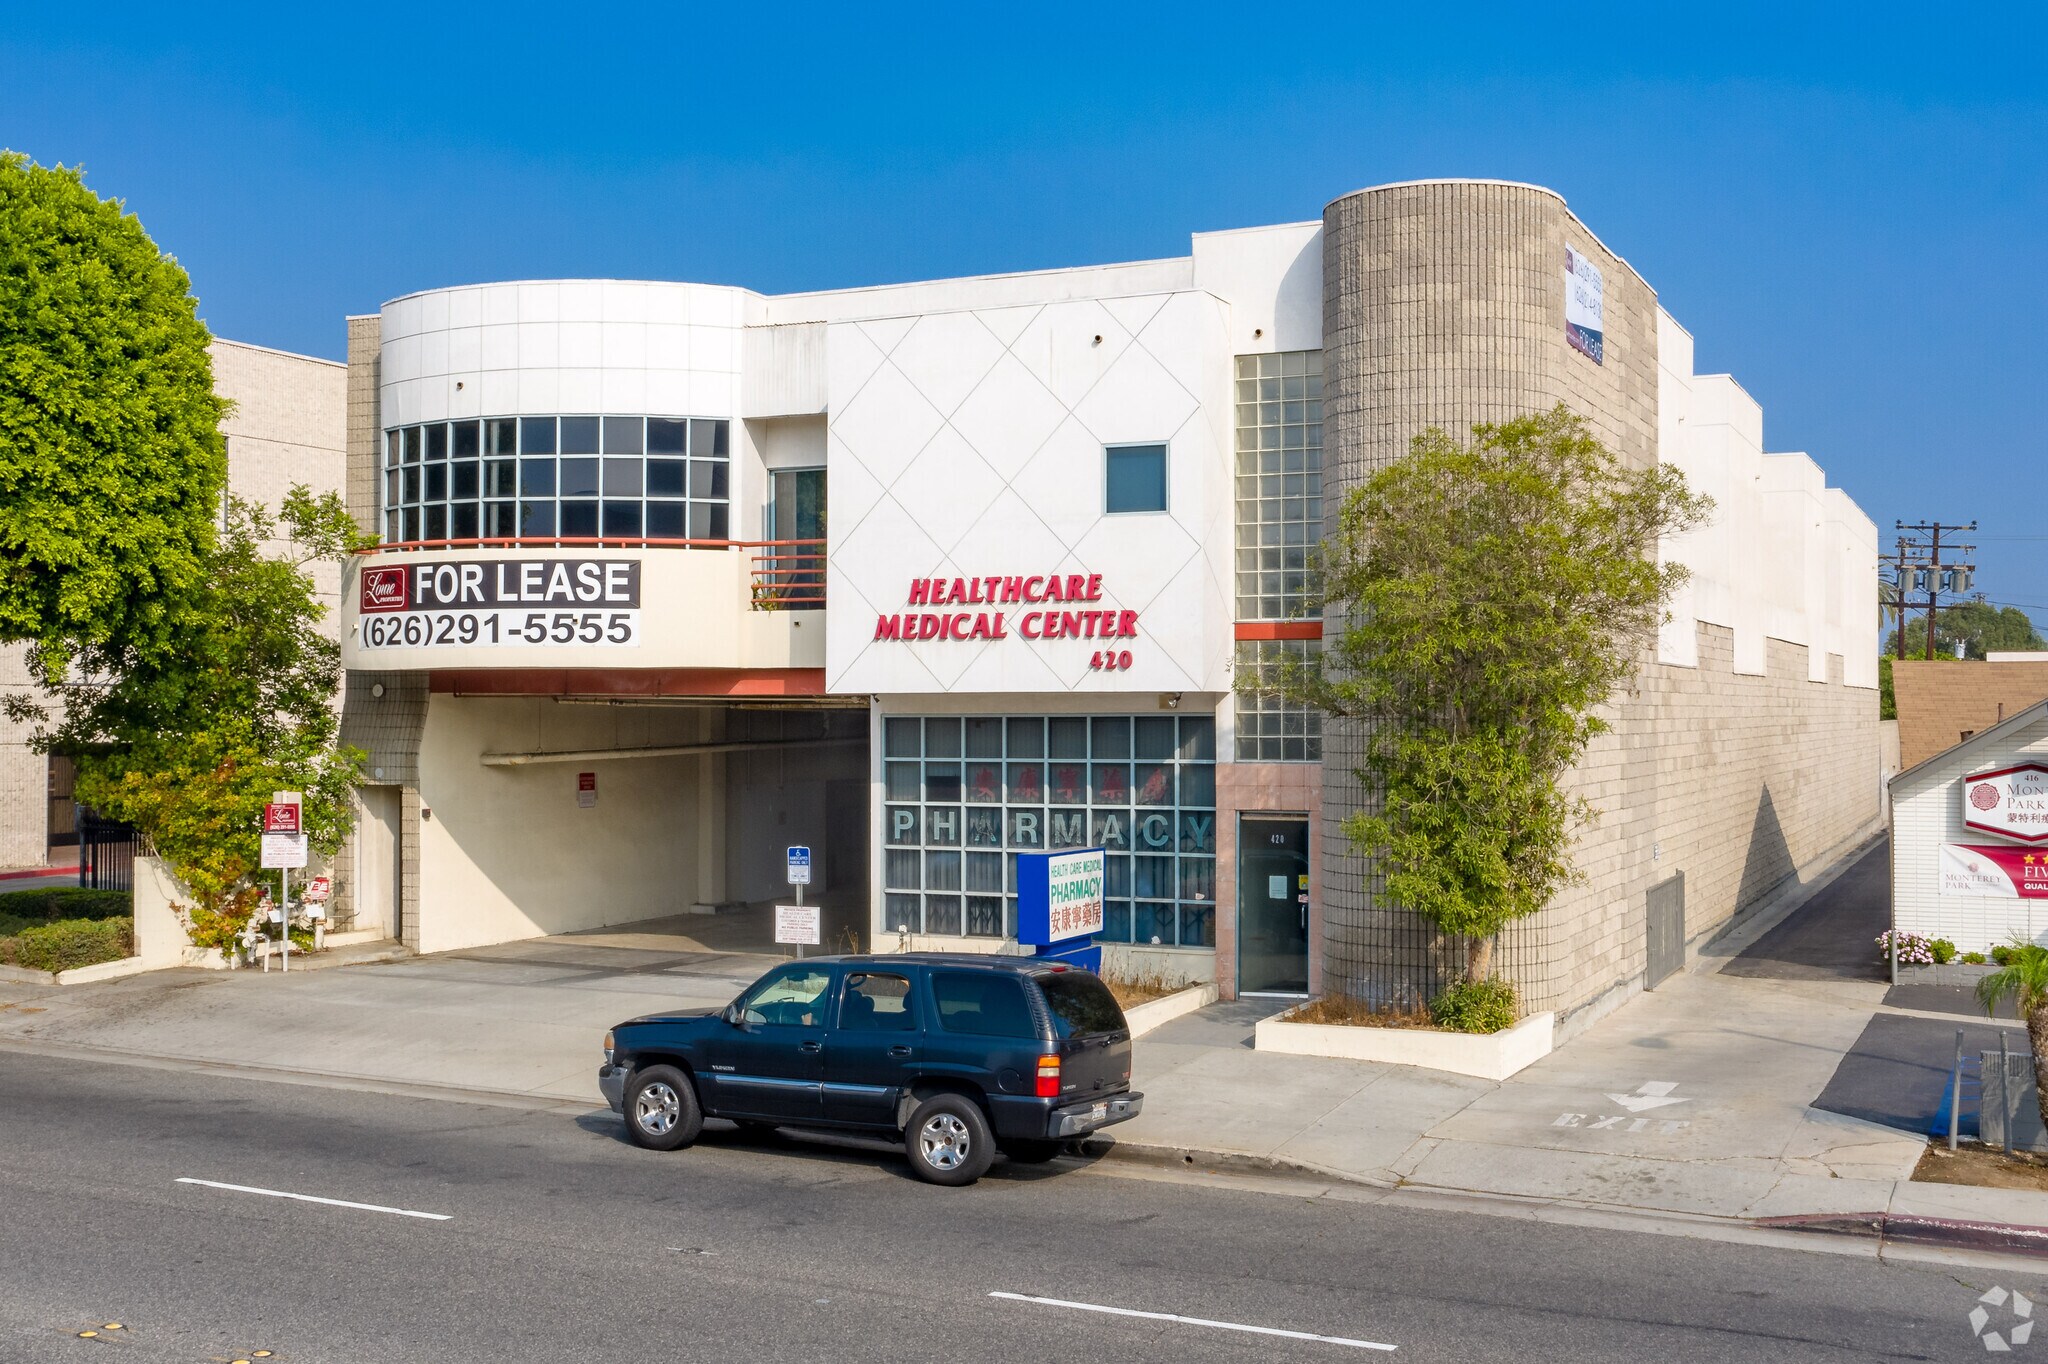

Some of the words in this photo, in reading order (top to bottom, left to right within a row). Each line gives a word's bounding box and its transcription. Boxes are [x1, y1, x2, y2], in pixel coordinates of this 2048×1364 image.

[416, 564, 485, 604] FOR
[497, 563, 630, 601] LEASE
[908, 574, 1103, 604] HEALTHCARE
[363, 613, 632, 647] (626)291-5555
[874, 612, 1007, 640] MEDICAL
[1020, 610, 1139, 638] CENTER
[1090, 650, 1133, 670] 420
[2007, 784, 2048, 795] MON
[2008, 797, 2045, 810] PARK
[893, 809, 1212, 848] PHARMACY
[1271, 834, 1284, 844] 420
[1051, 864, 1068, 878] HEALTH
[1070, 861, 1082, 875] CARE
[1083, 859, 1102, 873] MEDICAL
[1946, 874, 2000, 883] MONTEREY
[1051, 877, 1102, 905] PHARMACY
[1551, 1113, 1690, 1136] EXIT
